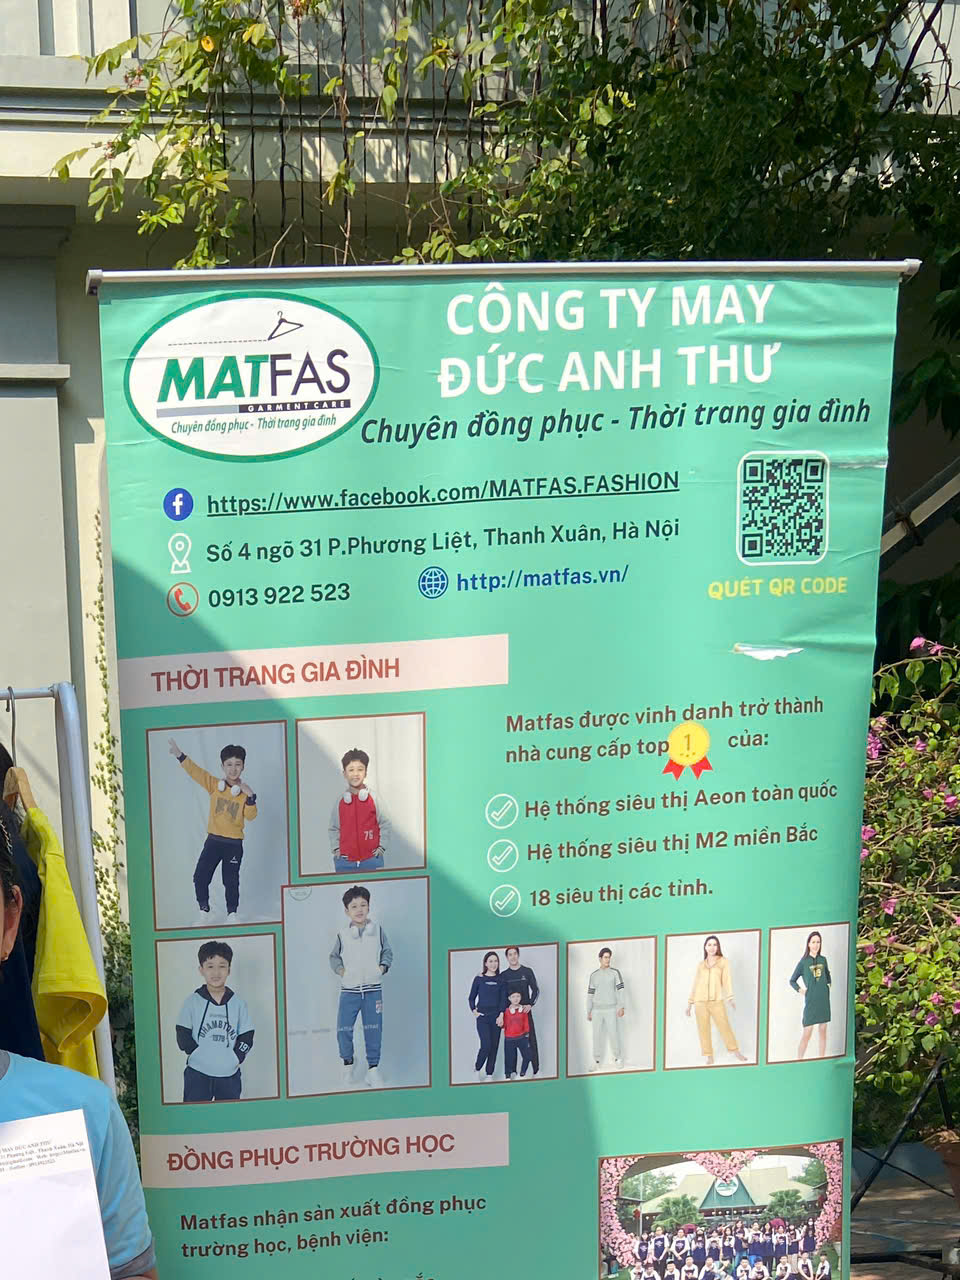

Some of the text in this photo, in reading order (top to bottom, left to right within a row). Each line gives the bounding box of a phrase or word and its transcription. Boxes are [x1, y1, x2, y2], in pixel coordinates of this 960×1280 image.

[447, 282, 775, 335] CÔNG TY MAY
[157, 348, 351, 403] MATFAS
[437, 342, 781, 398] ĐỨC ANH THƯ
[247, 400, 346, 413] GARMENT CARE
[361, 415, 457, 449] Chuyên
[467, 409, 533, 442] đồng
[539, 408, 604, 441] phục
[629, 402, 687, 430] Thời
[694, 404, 766, 430] trang
[772, 398, 811, 430] gia
[818, 398, 870, 423] đình
[207, 471, 680, 516] https://www.facebook.com/MATFAS.FASHION
[207, 518, 679, 563] Số 4 ngõ 31 P.Phương Liệt, Thanh Xuân, Hà Nội
[208, 583, 350, 608] 0913 922 523
[457, 565, 629, 594] http://matfas.vn/
[708, 576, 848, 599] QUÉT QR CODE
[150, 654, 399, 692] THỜI TRANG GIA ĐÌNH
[506, 696, 823, 733] Matfas được vinh danh trở thành
[506, 744, 540, 763] nhà
[546, 745, 592, 762] cung
[597, 737, 631, 759] cấp
[636, 739, 670, 757] top
[728, 729, 768, 748] của:
[525, 779, 838, 818] Hệ thống siêu thị Aeon toàn quốc
[530, 878, 713, 906] 18 siêu thị các tỉnh.
[166, 1134, 455, 1171] ĐỒNG PHỤC TRƯỜNG HỌC
[181, 1195, 486, 1230] Matfas nhận sản xuất đồng phục
[181, 1228, 388, 1258] trường học, bệnh viện:
